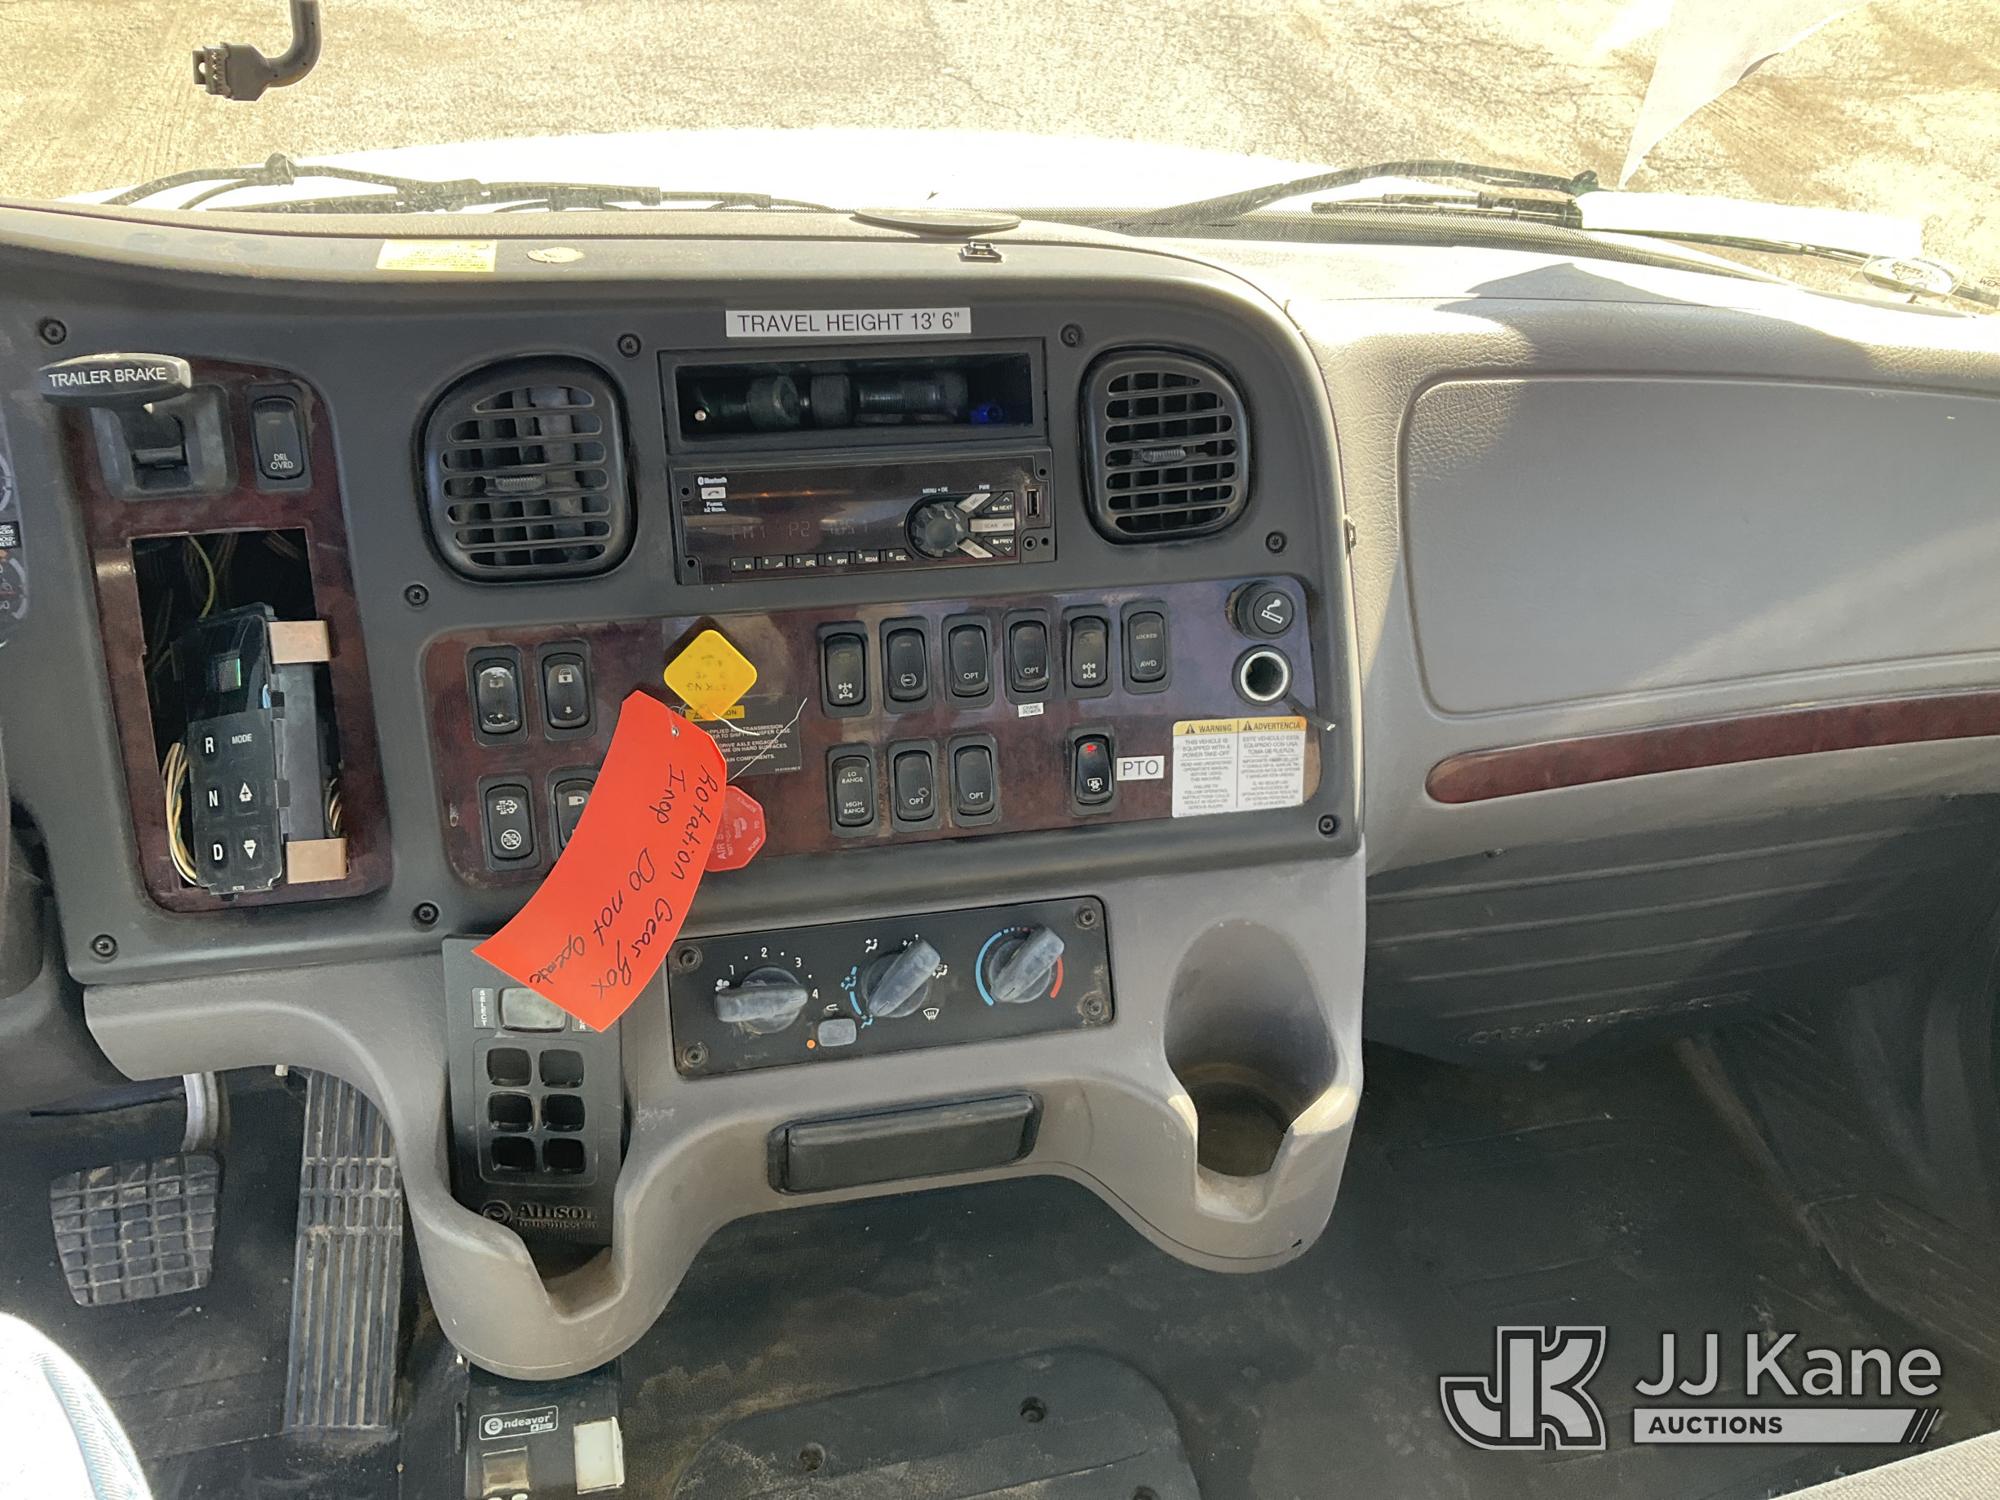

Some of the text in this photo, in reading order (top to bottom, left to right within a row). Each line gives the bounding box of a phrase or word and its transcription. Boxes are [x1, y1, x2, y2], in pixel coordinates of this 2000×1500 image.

[737, 312, 960, 332] TRAVEL HEIGHT 13' 6"
[48, 367, 167, 387] TRAILER BRAKE
[270, 460, 294, 470] OVRD
[1024, 666, 1039, 674] OPT
[964, 672, 979, 680] OPT
[1199, 724, 1232, 733] WARNING
[1253, 721, 1301, 730] ADVERTENCIA
[232, 733, 253, 744] MODE
[205, 737, 214, 753] R
[1122, 760, 1159, 776] PTO
[208, 790, 219, 808] N
[909, 797, 924, 805] OPT
[969, 792, 984, 800] OPT
[213, 843, 223, 861] D
[761, 947, 768, 958] 2
[795, 957, 802, 968] 3
[729, 965, 735, 975] 1
[812, 988, 819, 999] 4
